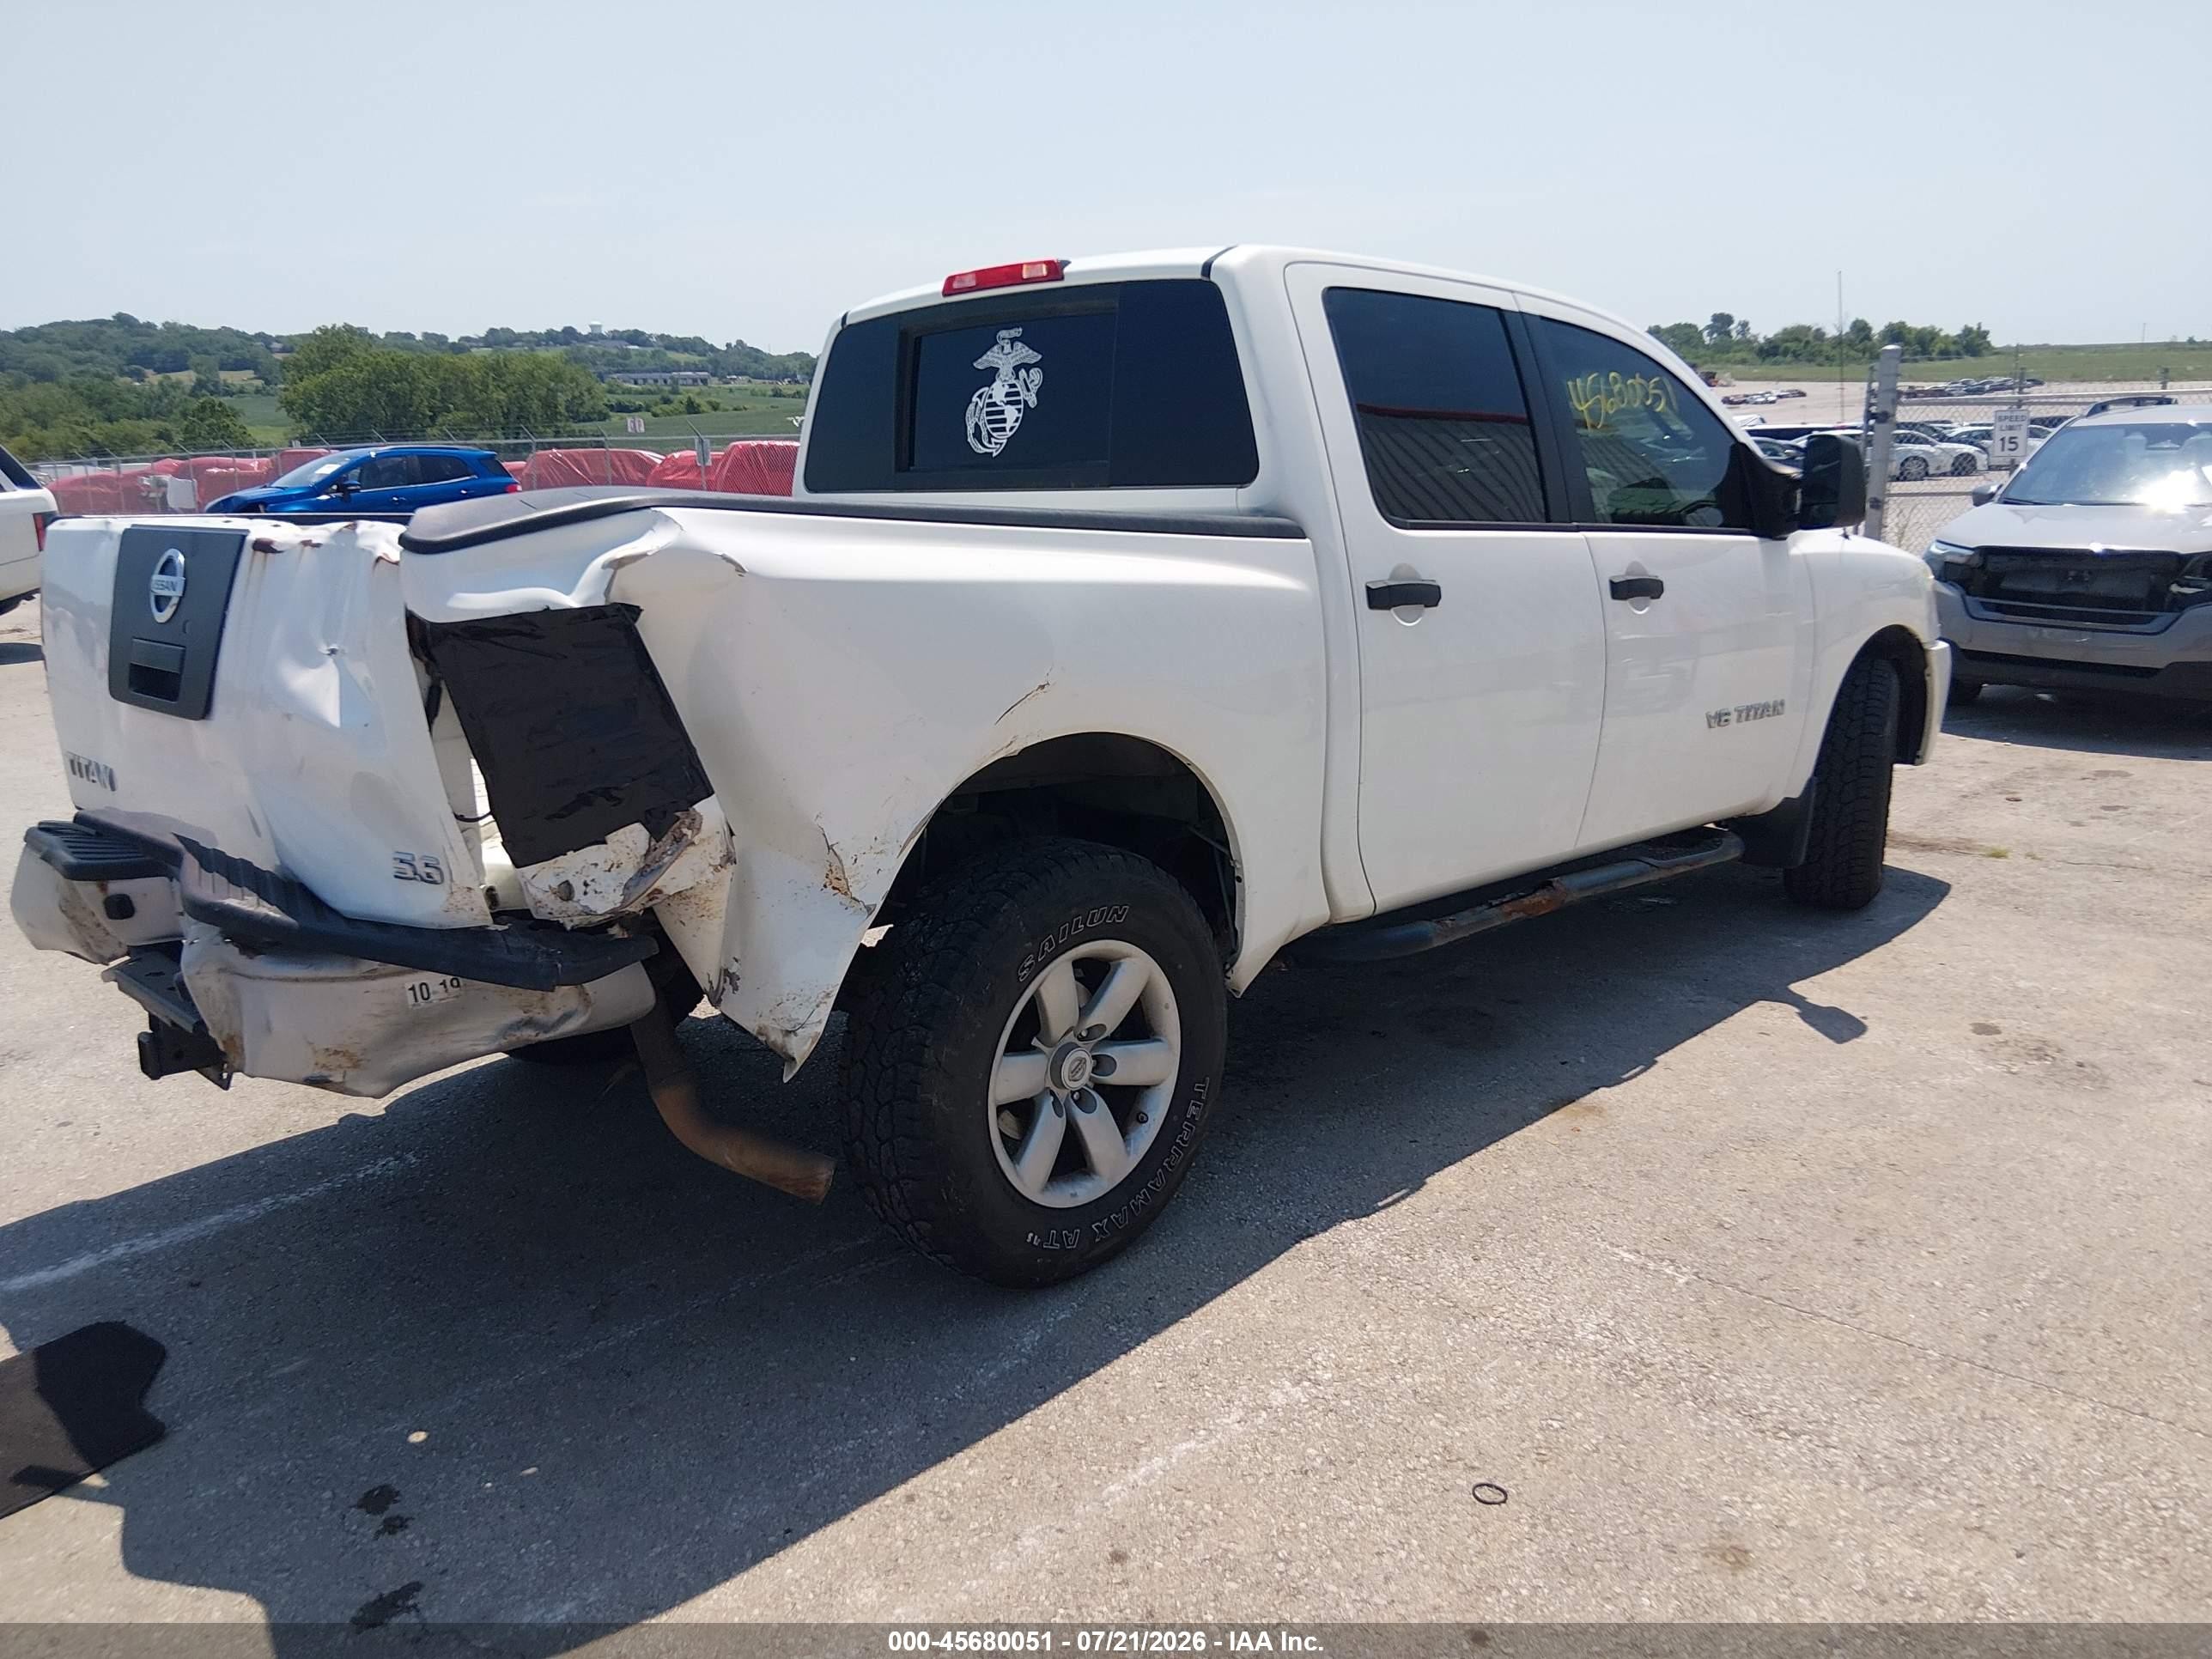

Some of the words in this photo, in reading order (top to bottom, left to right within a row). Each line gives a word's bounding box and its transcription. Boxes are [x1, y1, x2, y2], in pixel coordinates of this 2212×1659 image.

[1999, 435, 2020, 453] 15
[1734, 698, 1786, 724] TITAN
[67, 750, 117, 792] TITAN
[1018, 904, 1131, 983] SAILUN
[408, 981, 431, 1003] 10
[1094, 1076, 1211, 1243] TERRAMAX
[1043, 1229, 1080, 1249] AT
